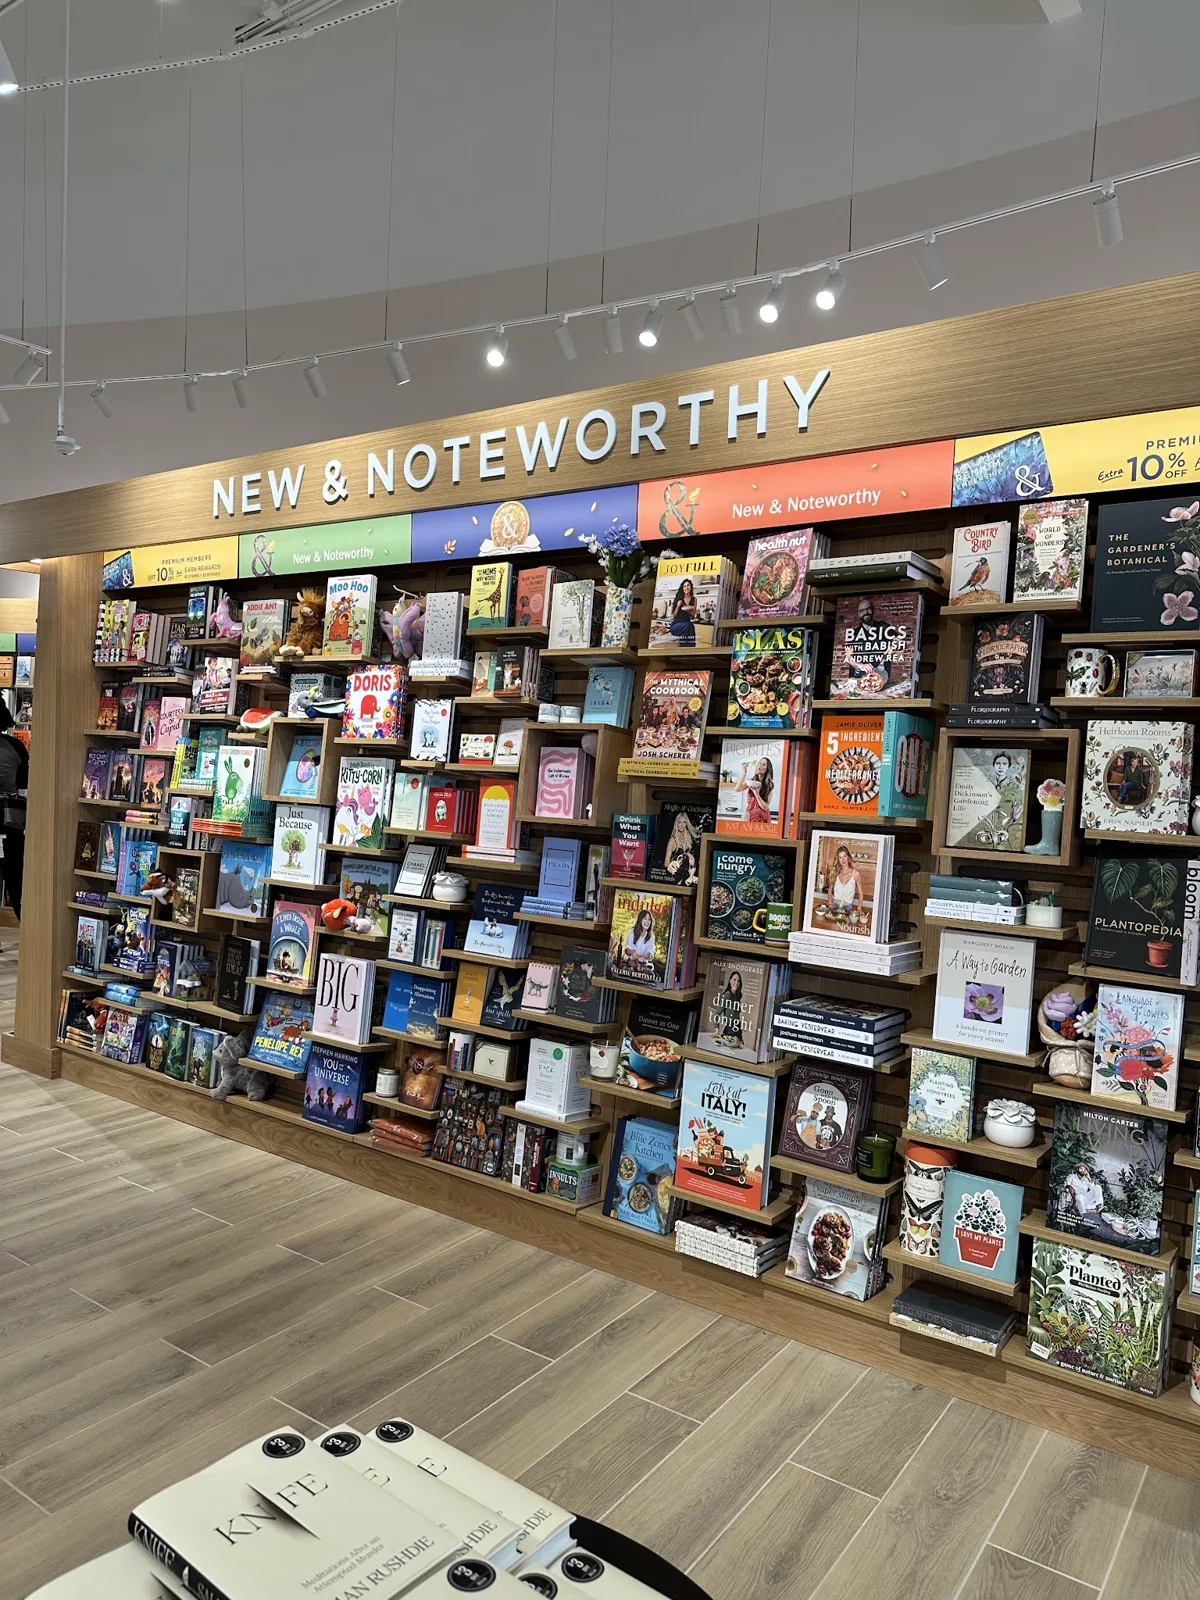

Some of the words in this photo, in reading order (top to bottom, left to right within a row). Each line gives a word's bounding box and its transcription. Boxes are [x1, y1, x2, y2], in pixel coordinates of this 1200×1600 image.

[213, 465, 306, 518] NEW
[322, 459, 349, 504] &
[368, 369, 832, 497] NOTEWORTHY
[1146, 436, 1200, 450] PREMI
[1098, 469, 1123, 481] Extra
[1127, 452, 1185, 481] 10%
[1165, 469, 1187, 478] OFF
[732, 501, 762, 519] New
[769, 498, 782, 515] &
[788, 488, 882, 512] Noteworthy
[963, 527, 999, 543] COUNTRY
[1039, 526, 1061, 534] WORLD
[755, 536, 788, 551] health
[789, 535, 807, 547] nut
[971, 538, 992, 552] BIRD
[1107, 543, 1176, 554] GARDENER'S
[293, 553, 311, 564] New
[314, 551, 321, 562] &
[324, 546, 374, 561] Noteworthy
[1106, 556, 1168, 566] BOTANICAL
[482, 567, 496, 575] MOMS
[664, 562, 717, 574] JOYFULL
[246, 603, 263, 612] ADDIE
[264, 602, 277, 610] ANT
[735, 629, 803, 651] ISLAS
[844, 625, 907, 642] BASICS
[845, 643, 864, 651] WITH
[865, 640, 906, 650] BABISH
[843, 653, 883, 663] ANDREW
[885, 654, 905, 662] REA
[353, 674, 391, 692] DORIS
[650, 687, 700, 695] COOKBOOK
[160, 722, 181, 736] Cupid
[1099, 727, 1139, 736] Heirloom
[1141, 727, 1172, 737] Rooms
[826, 732, 839, 755] 5
[954, 798, 989, 806] Gardening
[287, 807, 303, 819] Just
[619, 816, 641, 824] Drink
[279, 817, 313, 830] Because
[619, 823, 641, 832] What
[726, 822, 739, 830] KAT
[741, 823, 778, 834] ASHMORE
[619, 839, 640, 848] Want
[622, 832, 637, 841] You
[548, 861, 571, 869] PRADA
[717, 857, 756, 875] hungry
[722, 855, 753, 863] come
[1185, 867, 1197, 919] bloom
[931, 902, 969, 910] HOUSEPLANTS
[769, 914, 791, 922] BOOKS
[929, 909, 967, 918] HOUSEPLANTS
[836, 921, 871, 936] Nourish
[1095, 917, 1182, 937] PLANTOPEDIA
[963, 939, 994, 950] MARGARET
[728, 962, 763, 974] SNODGRASS
[947, 950, 959, 967] A
[962, 953, 979, 979] Way
[980, 956, 989, 972] to
[990, 957, 1027, 978] Garden
[317, 957, 363, 1013] BIG
[713, 993, 753, 1014] dinner
[496, 1009, 511, 1018] spells
[779, 1006, 798, 1015] joshua
[799, 1009, 824, 1020] weissman
[638, 1015, 656, 1026] Dinner
[658, 1019, 665, 1027] in
[667, 1021, 679, 1030] One
[709, 1011, 753, 1032] tonight
[777, 1018, 798, 1028] BAKING
[800, 1021, 835, 1034] YESTERYEAR
[779, 1029, 798, 1038] joshua
[799, 1032, 824, 1044] weissman
[985, 1036, 1005, 1045] season
[988, 1029, 1009, 1039] primer
[254, 1036, 288, 1051] PENELOPE
[289, 1043, 304, 1060] REX
[312, 1045, 333, 1056] STEPHEN
[334, 1051, 358, 1064] HAWKING
[776, 1040, 798, 1051] BAKING
[800, 1044, 834, 1057] YESTERYEAR
[323, 1057, 339, 1070] YOU
[314, 1067, 350, 1086] UNIVERSE
[704, 1081, 725, 1096] Let's
[726, 1086, 747, 1101] Eat
[814, 1085, 834, 1095] Goon
[929, 1079, 954, 1089] PLANTING
[813, 1094, 836, 1105] Spoon
[926, 1088, 956, 1100] HONEYBEES
[701, 1093, 747, 1118] ITALY!
[1084, 1112, 1109, 1121] HILTON
[1111, 1118, 1139, 1128] CARTER
[1077, 1116, 1144, 1145] LIVING
[630, 1131, 646, 1143] Blue
[648, 1135, 673, 1152] Zones
[1087, 1131, 1142, 1160] WILD
[634, 1140, 665, 1161] Kitchen
[549, 1169, 577, 1185] INSULTS
[961, 1231, 972, 1239] LOVE
[983, 1236, 1002, 1247] PLANTS
[1066, 1264, 1121, 1290] Planted
[907, 1308, 953, 1327] GARDENS
[918, 1326, 933, 1334] SMALL
[935, 1331, 956, 1341] GARDEN
[957, 1338, 972, 1347] STYLE
[1060, 1361, 1073, 1369] game
[1082, 1368, 1099, 1378] nature
[1105, 1375, 1126, 1387] nurture
[269, 1438, 286, 1447] $3
[326, 1437, 342, 1446] $3
[134, 1520, 175, 1568] KNIFE
[301, 1550, 350, 1589] Meditations
[348, 1540, 370, 1559] After
[369, 1536, 381, 1545] an
[372, 1534, 436, 1588] RUSHDIE
[567, 1558, 584, 1569] $3
[312, 1560, 355, 1594] Attempted
[353, 1543, 385, 1565] Murder
[454, 1565, 473, 1577] $3
